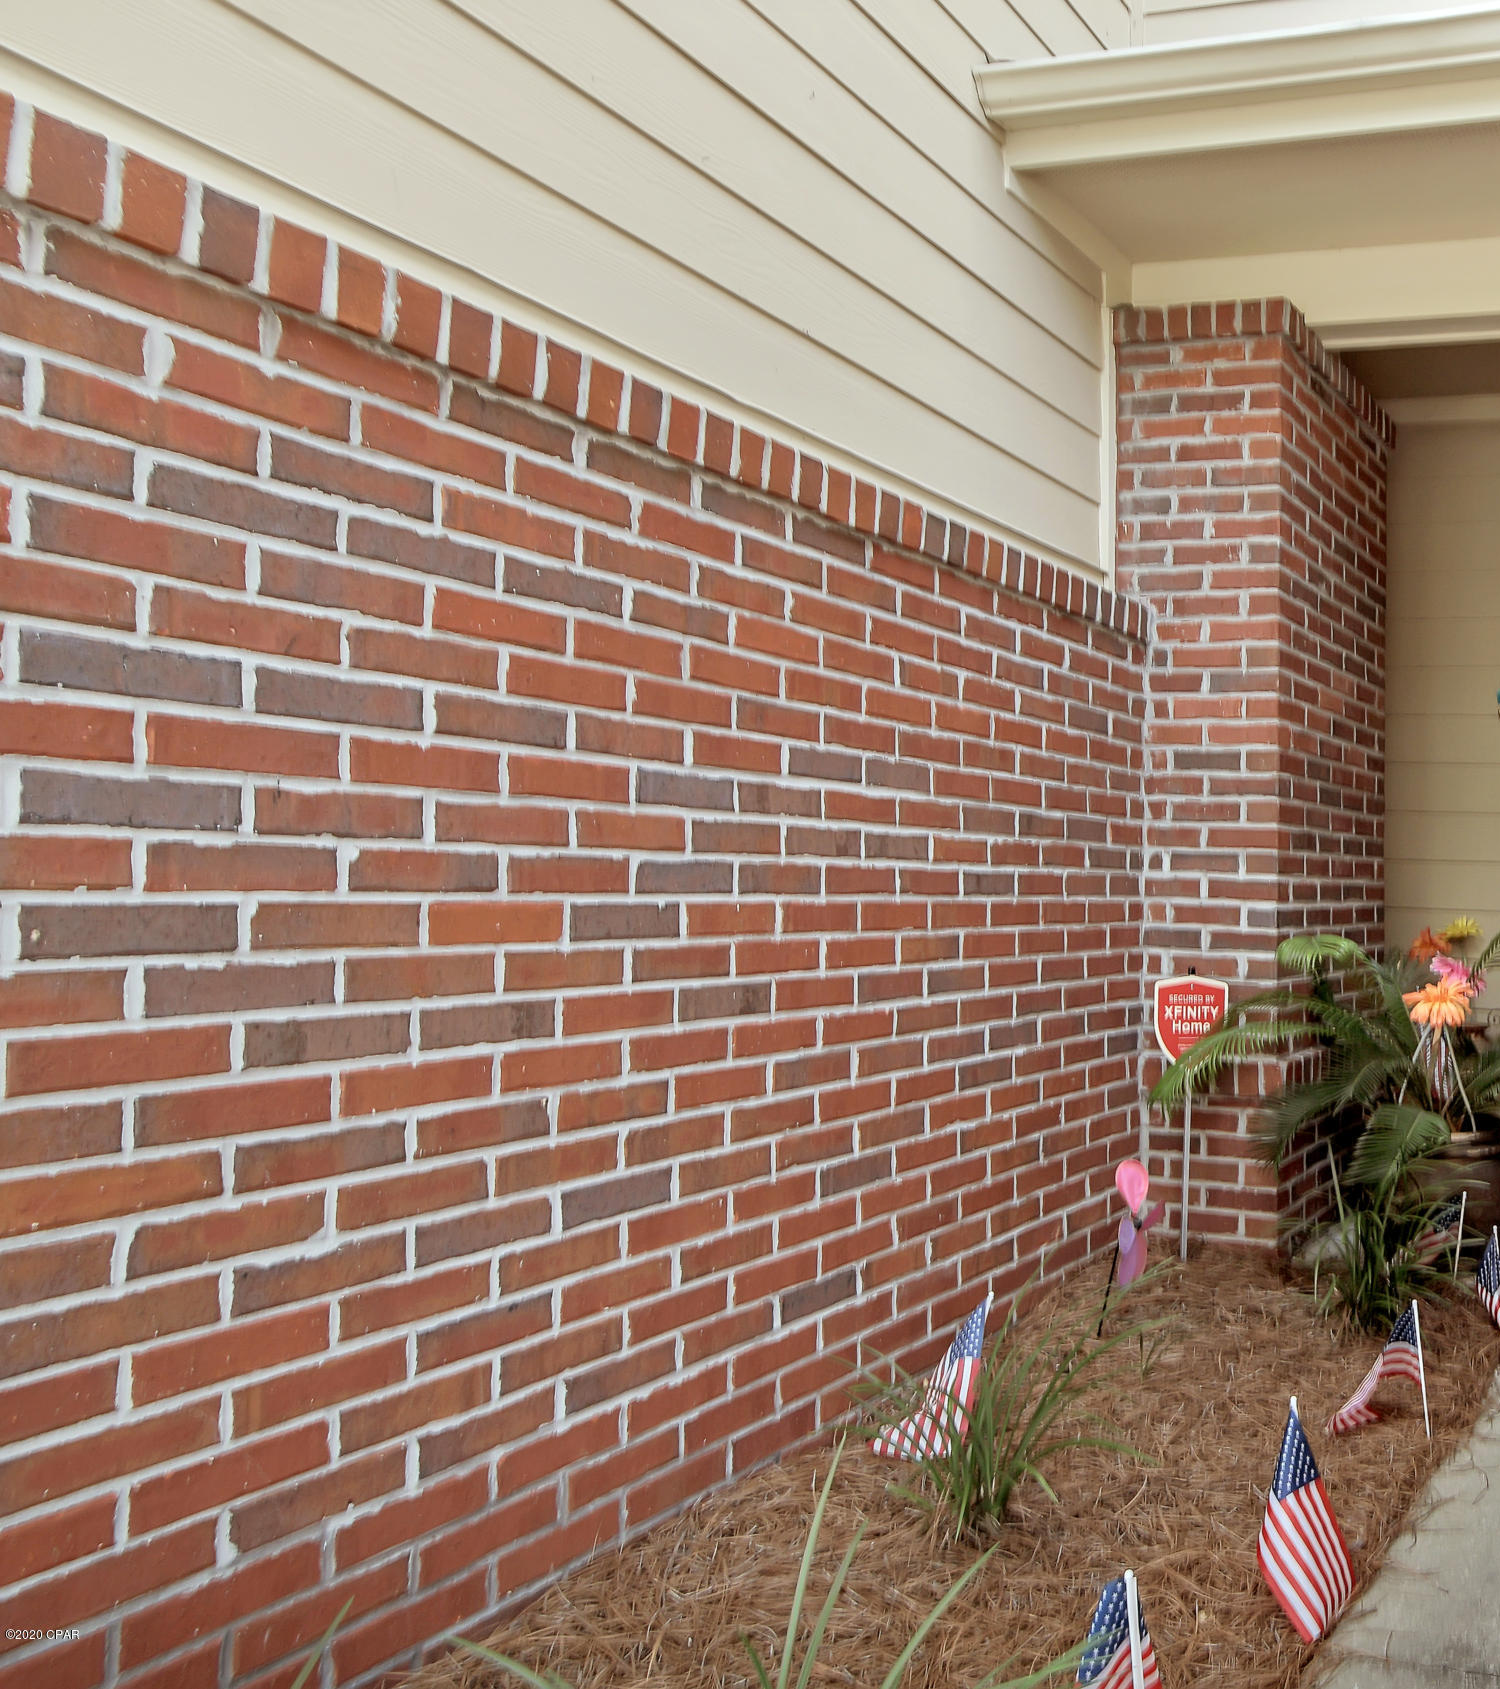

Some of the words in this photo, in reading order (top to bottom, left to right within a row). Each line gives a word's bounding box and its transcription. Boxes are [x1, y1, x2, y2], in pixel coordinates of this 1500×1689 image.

[1169, 994, 1203, 1004] SECURED
[1205, 994, 1214, 1004] BY
[1164, 1005, 1219, 1020] XFINITY
[1172, 1019, 1211, 1035] Home
